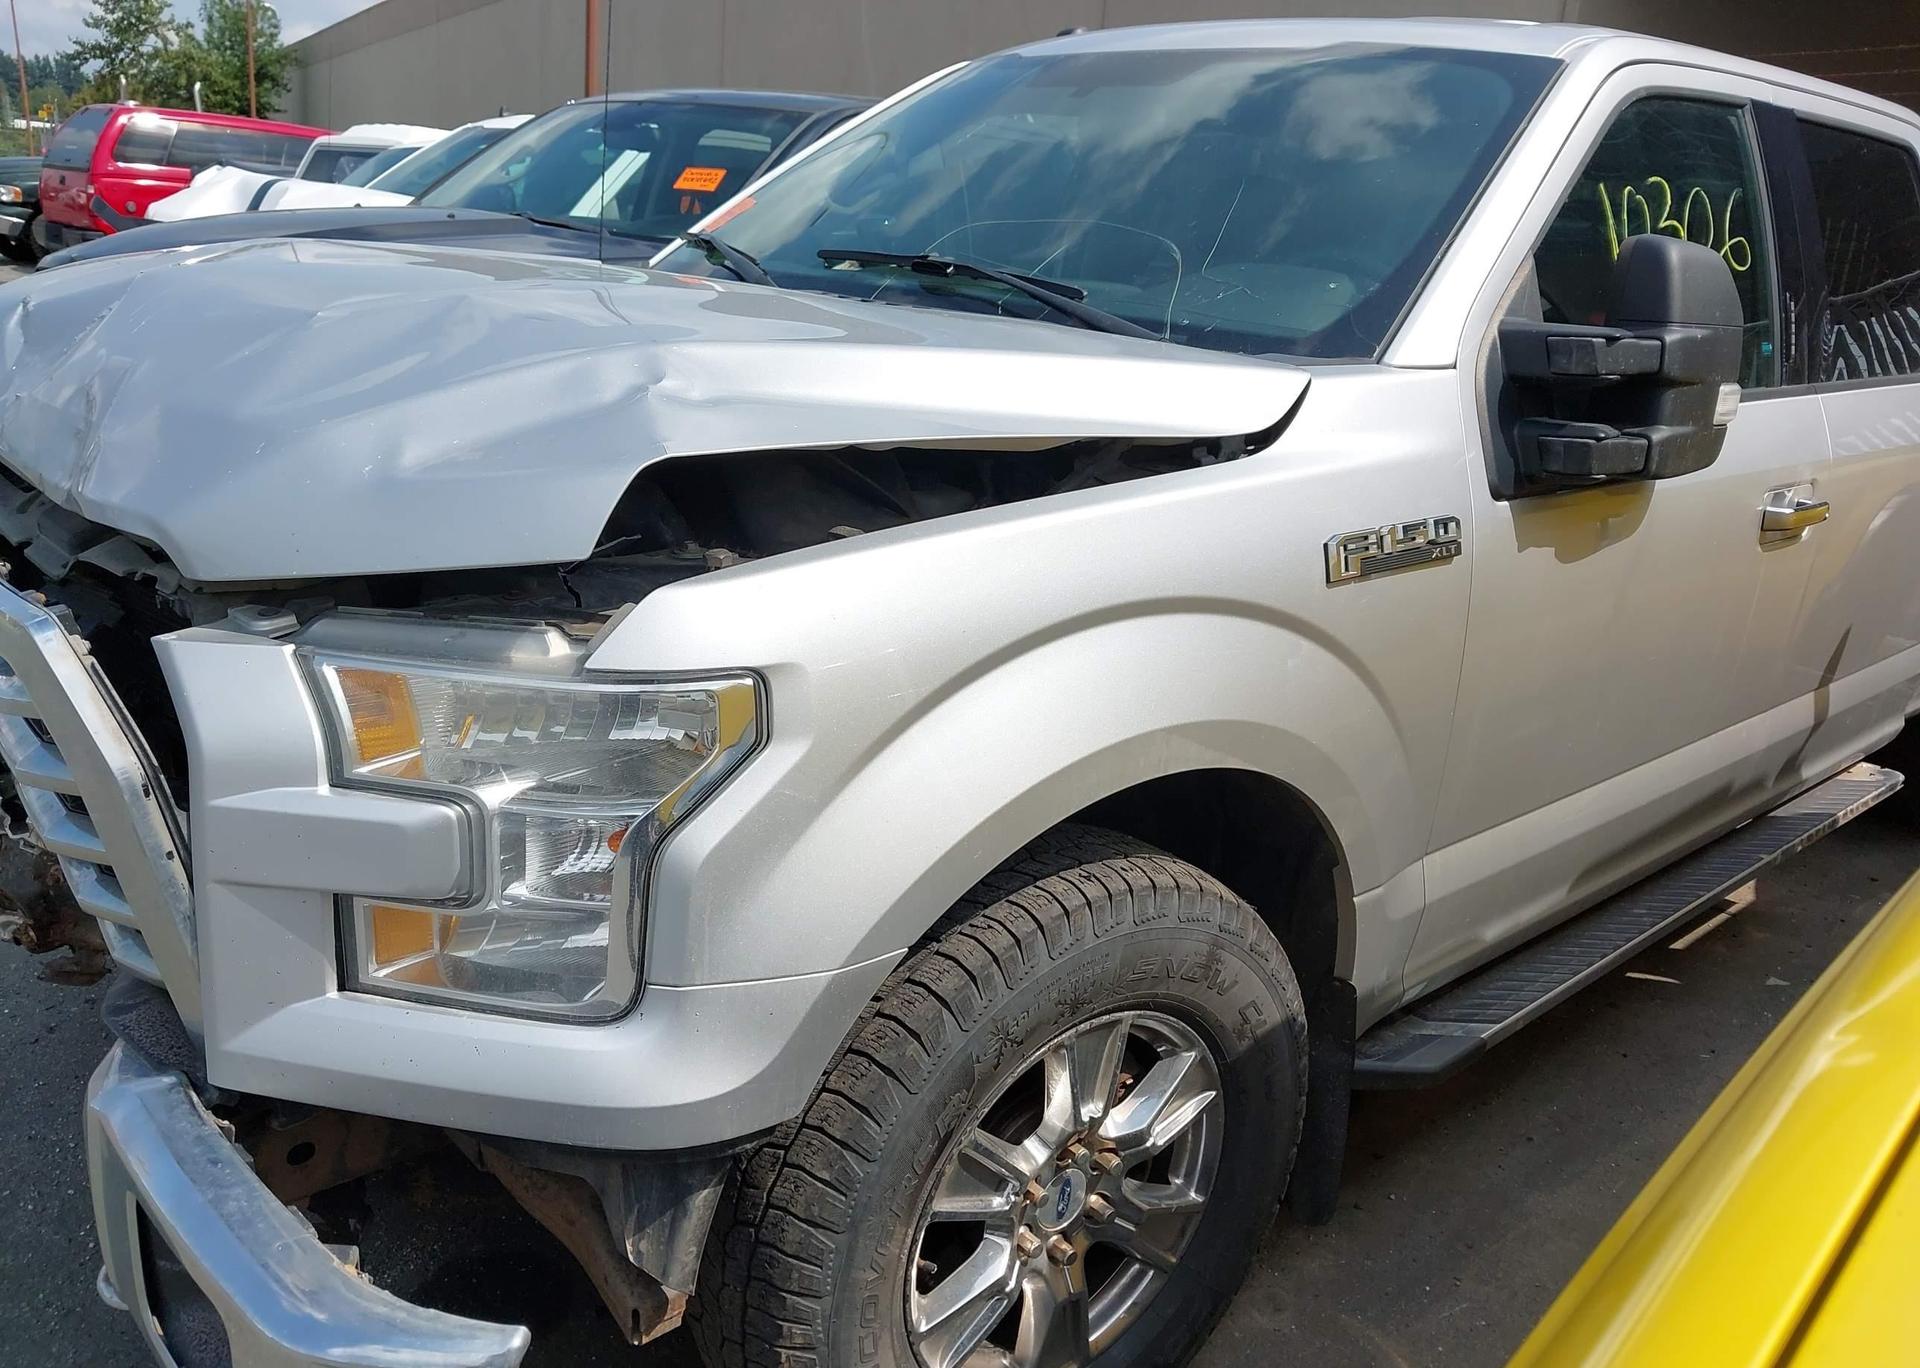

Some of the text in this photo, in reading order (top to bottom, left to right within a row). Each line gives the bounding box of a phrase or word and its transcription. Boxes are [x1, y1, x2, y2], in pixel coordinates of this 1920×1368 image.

[1599, 176, 1751, 271] 10306
[1323, 514, 1462, 583] F150
[1431, 544, 1458, 559] XLT
[1126, 956, 1239, 997] SNOW
[1056, 1186, 1072, 1213] Ford
